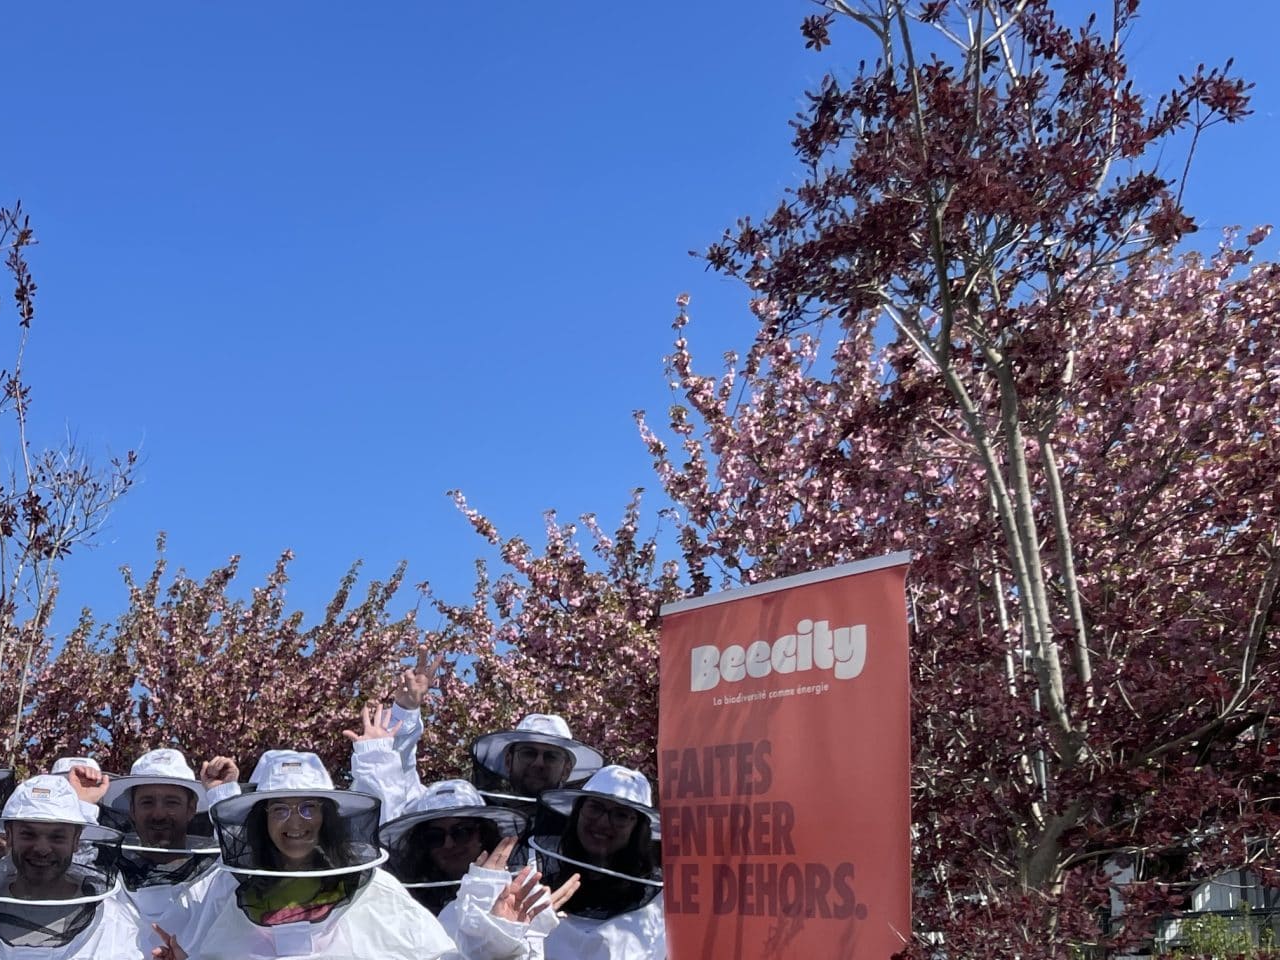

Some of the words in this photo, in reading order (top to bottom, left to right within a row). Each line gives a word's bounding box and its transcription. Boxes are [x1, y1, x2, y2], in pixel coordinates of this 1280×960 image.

[690, 618, 867, 692] Beecity
[796, 682, 829, 695] énergie
[663, 740, 773, 800] FAITES
[663, 801, 796, 857] ENTRER
[713, 862, 867, 921] DEHORS.
